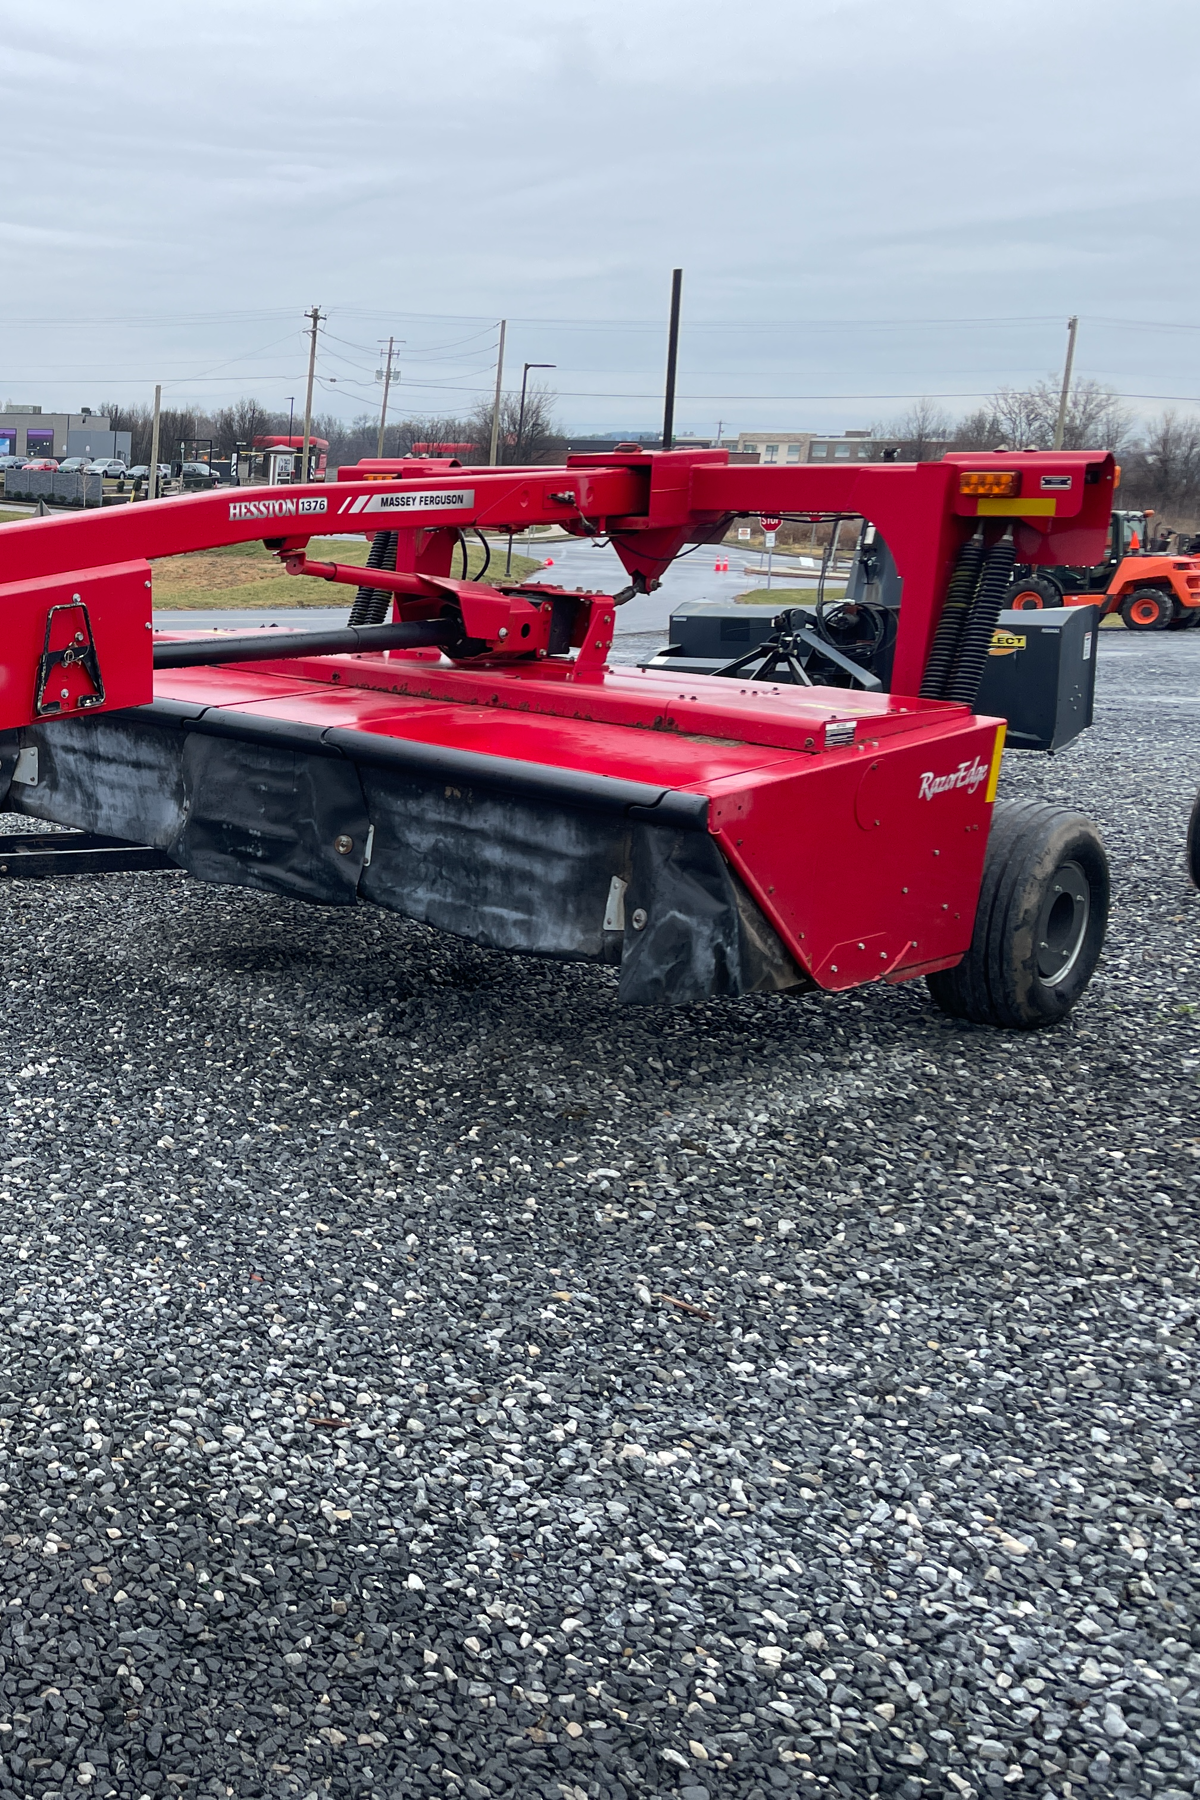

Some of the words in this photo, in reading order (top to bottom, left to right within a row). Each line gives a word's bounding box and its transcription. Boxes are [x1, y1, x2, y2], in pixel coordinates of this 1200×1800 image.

[229, 498, 297, 521] HESSTON
[301, 500, 326, 512] 1376
[381, 496, 417, 508] MASSEY
[419, 494, 464, 506] FERGUSON
[918, 755, 989, 801] RazorEdge
